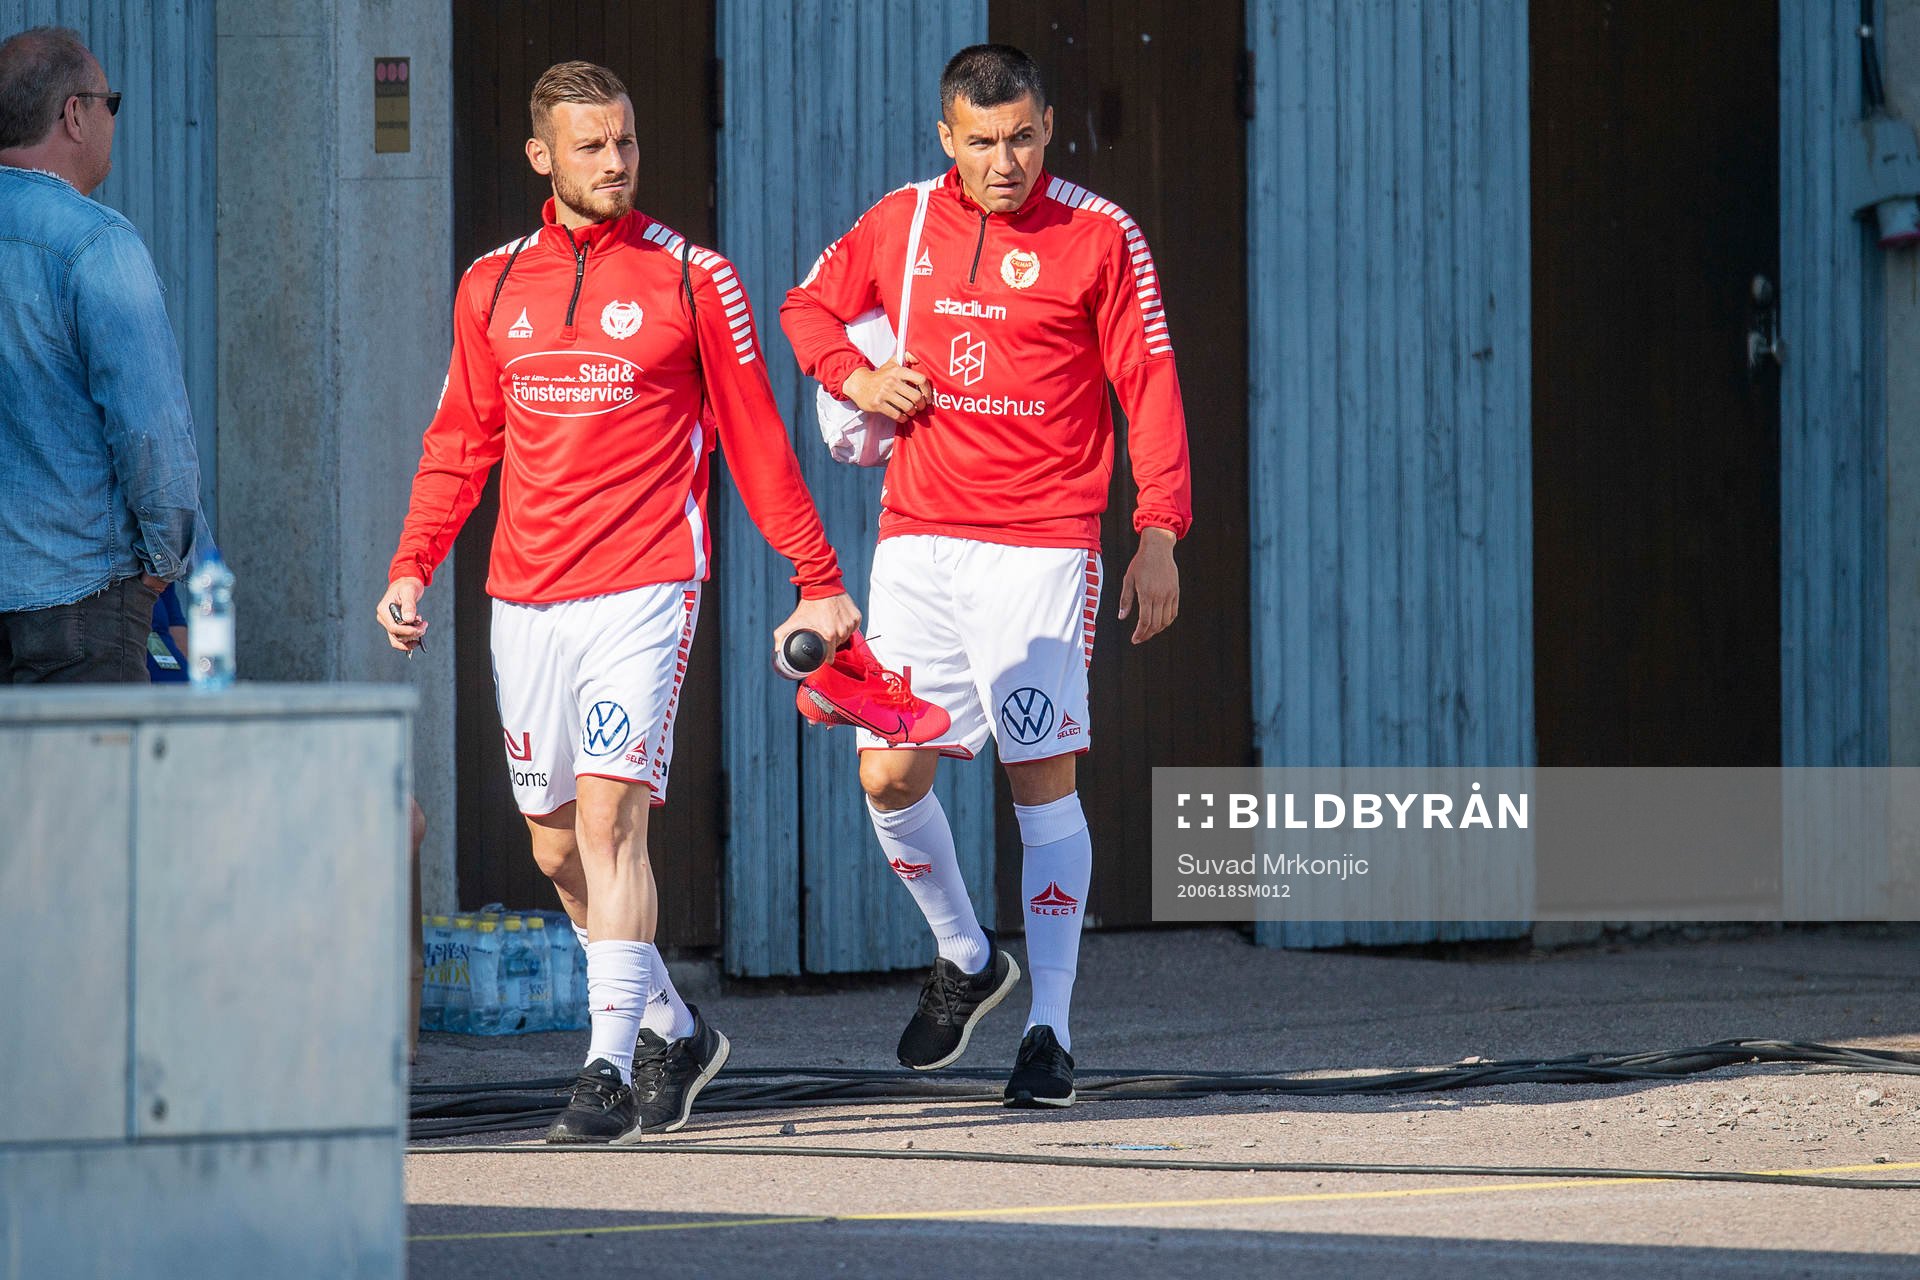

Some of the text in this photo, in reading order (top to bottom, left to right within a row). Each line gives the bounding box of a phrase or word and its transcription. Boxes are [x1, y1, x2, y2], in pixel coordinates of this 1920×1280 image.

[934, 298, 1007, 320] stadium
[507, 330, 533, 339] SELECT
[579, 363, 635, 383] Städ&
[512, 382, 634, 402] Fönsterservice
[932, 387, 1046, 417] tevadshus
[1056, 727, 1081, 740] SELECT
[625, 753, 649, 767] SELECT
[1030, 904, 1078, 916] SELECT
